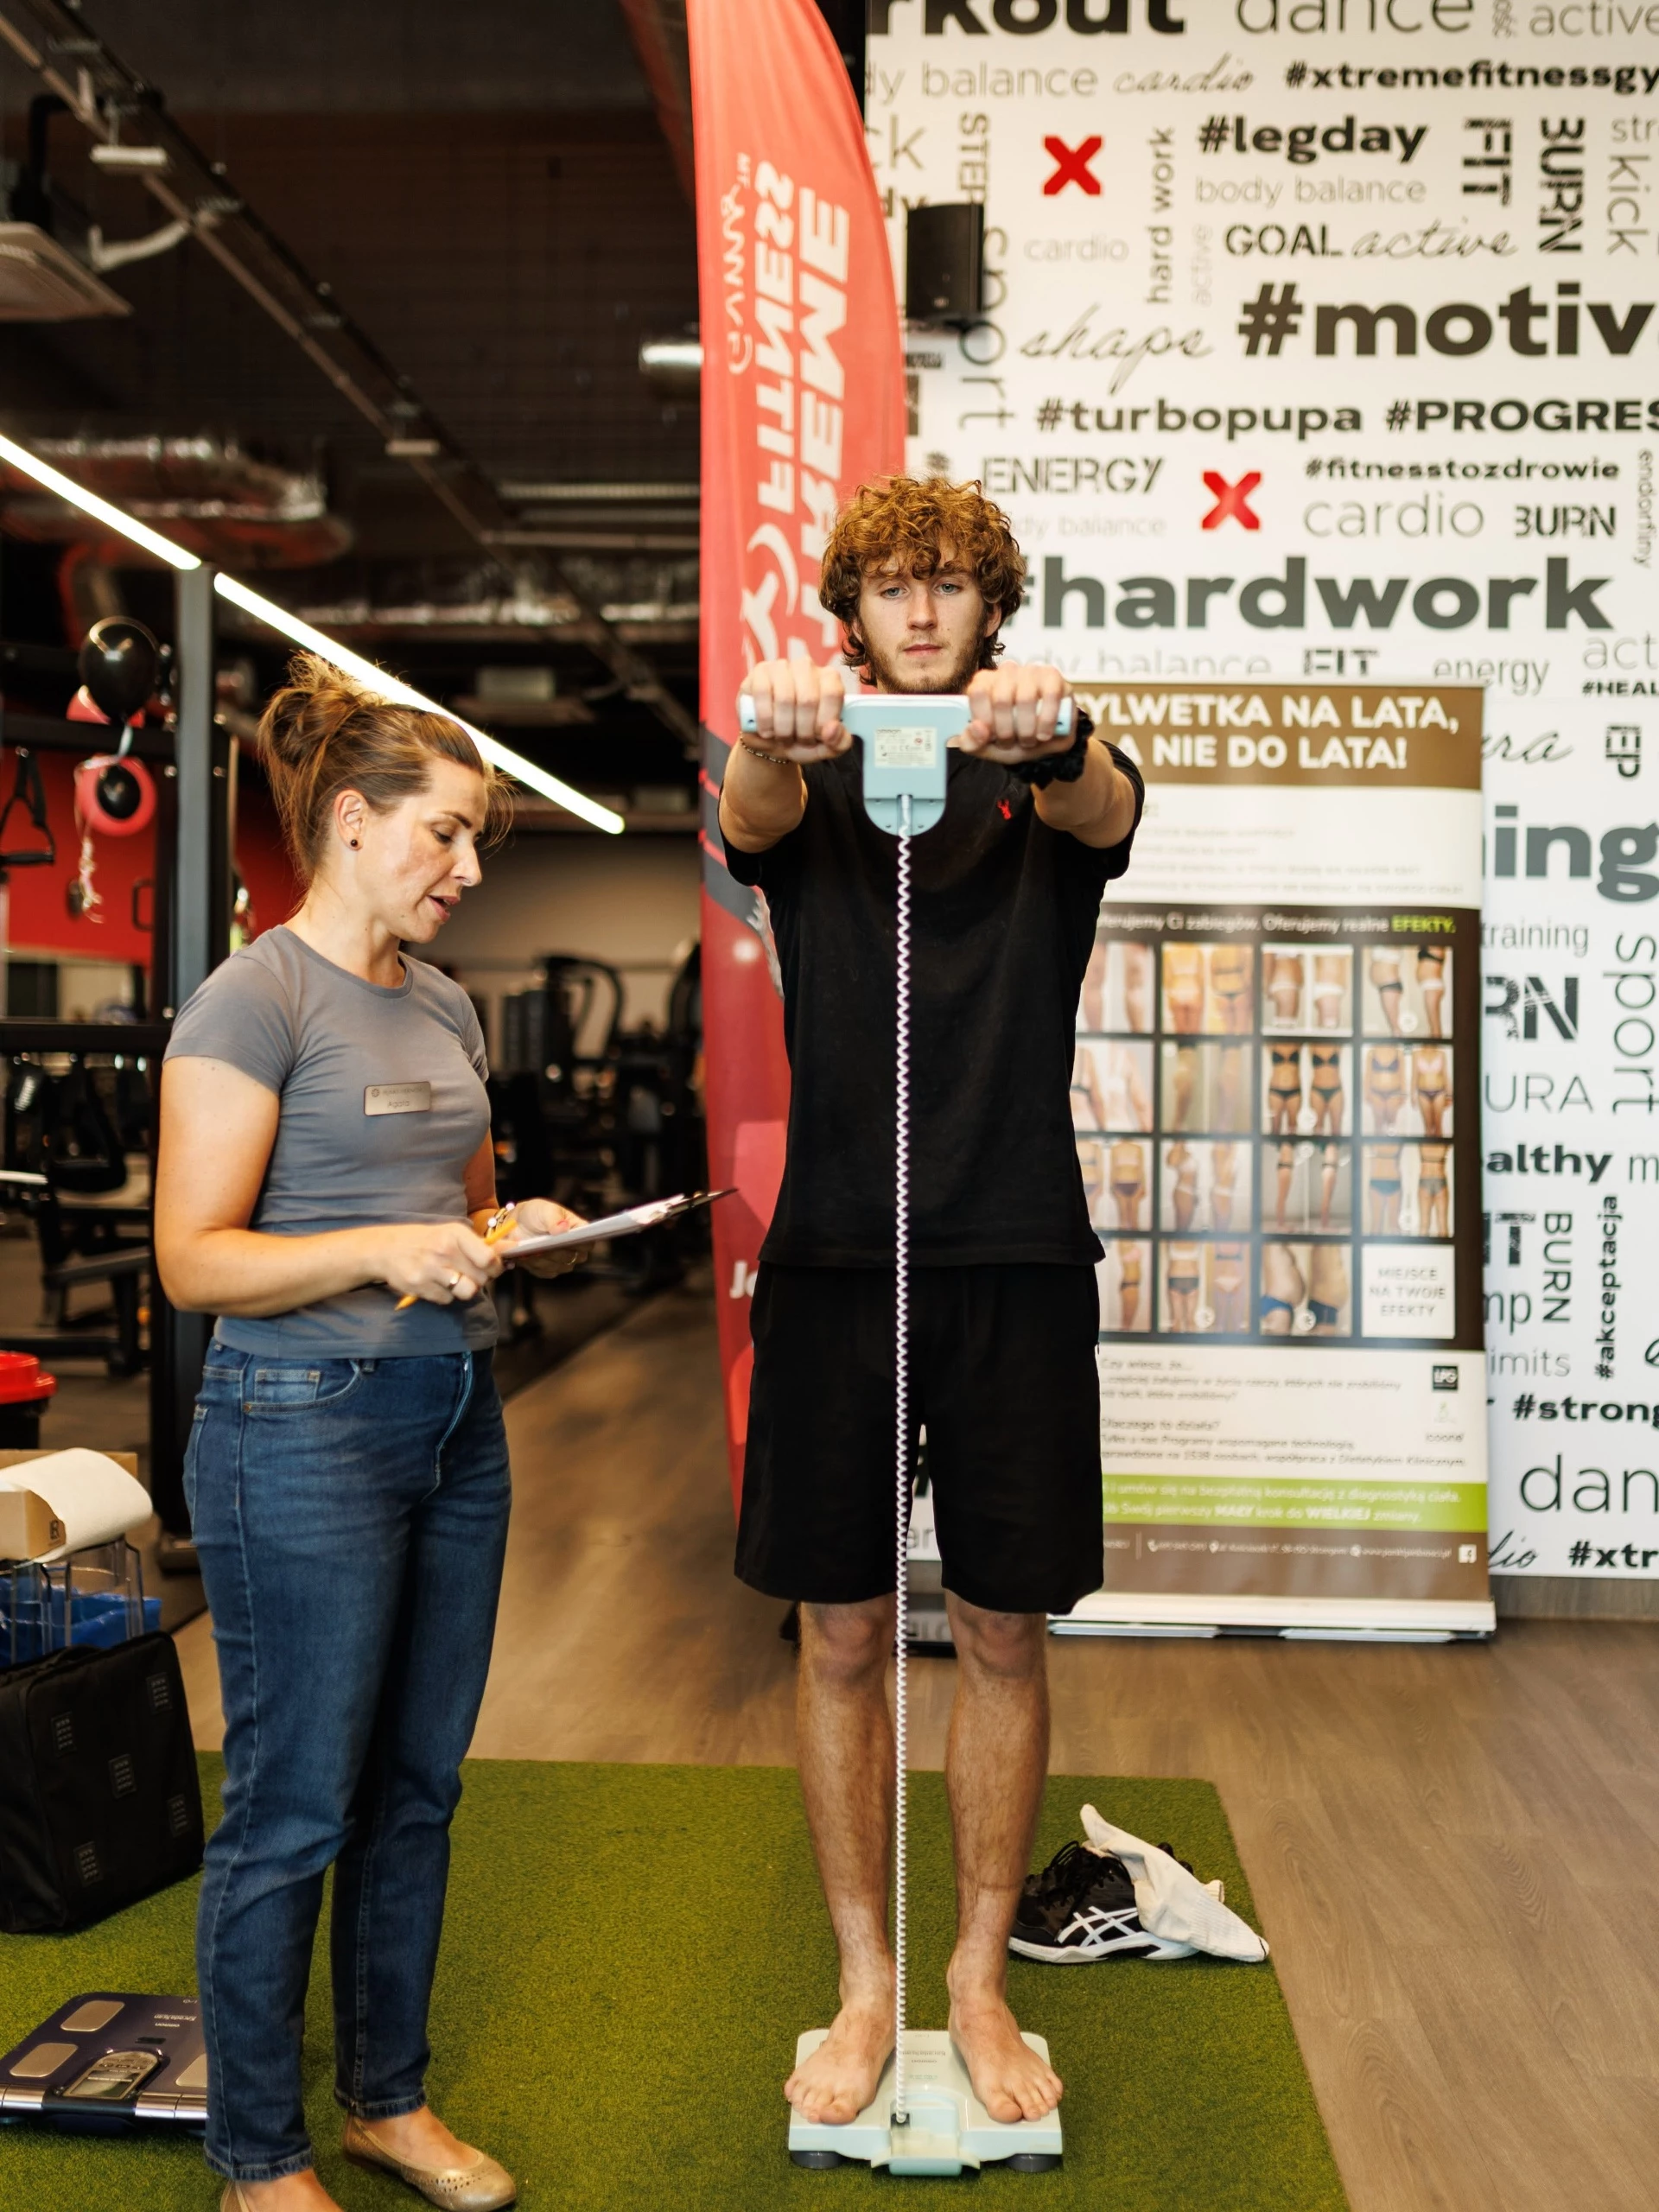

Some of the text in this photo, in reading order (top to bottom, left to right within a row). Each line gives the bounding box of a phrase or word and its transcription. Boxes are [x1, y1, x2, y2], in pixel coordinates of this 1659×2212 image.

[1236, 0, 1475, 35] dance
[921, 60, 1098, 99] balance
[1113, 52, 1255, 96] cardio
[1198, 116, 1428, 164] #legday
[1611, 114, 1659, 143] str
[1463, 118, 1512, 207] FIT
[1195, 176, 1427, 207] body balance
[1538, 118, 1586, 254] BURN
[1147, 126, 1175, 305] hard work
[1023, 234, 1130, 262] cardio
[1225, 224, 1343, 257] GOAL
[1351, 218, 1519, 258] active
[1237, 282, 1659, 359] #motiv
[1020, 302, 1215, 396] shape
[1036, 398, 1363, 442] #turbopupa
[982, 457, 1164, 493] ENERGY
[1305, 456, 1620, 480] #fitnesstozdrowie
[1303, 491, 1484, 538] cardio
[1514, 505, 1617, 537] BURN
[1302, 647, 1381, 677] FIT
[1281, 694, 1341, 728] NA
[1351, 696, 1459, 734] LATA,
[1152, 734, 1218, 767] NIE
[1227, 735, 1287, 769] DO
[1297, 736, 1408, 770] LATA!
[1482, 804, 1659, 901] ing
[1602, 932, 1659, 1115] sport
[1486, 1143, 1614, 1185] althy
[1542, 1212, 1573, 1323] BURN
[1595, 1195, 1623, 1380] #akceptacja
[1519, 1452, 1659, 1513] dan
